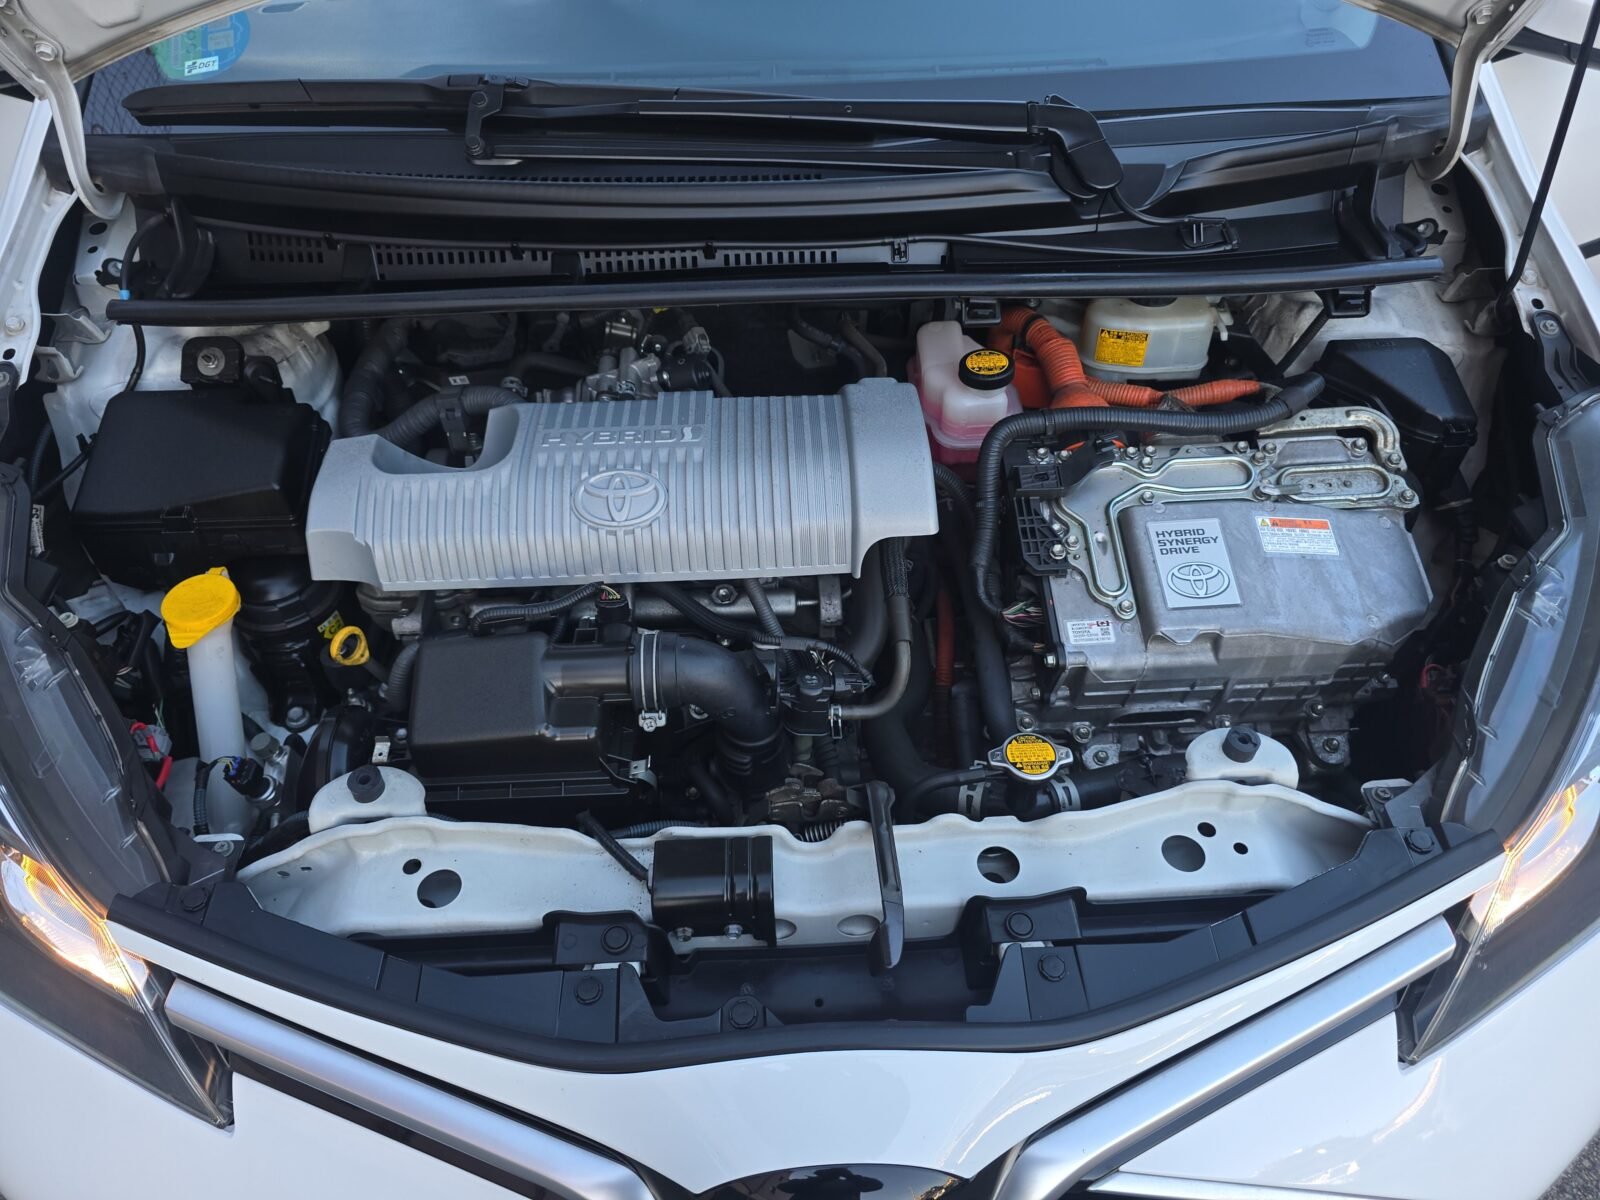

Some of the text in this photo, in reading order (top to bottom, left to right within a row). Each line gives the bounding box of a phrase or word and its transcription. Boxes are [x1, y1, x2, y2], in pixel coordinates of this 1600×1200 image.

[198, 60, 217, 69] DGT
[541, 429, 677, 447] HYBRID
[1156, 528, 1205, 538] HYBRID
[1157, 536, 1219, 547] SYNERGY
[1160, 546, 1201, 555] DRIVE
